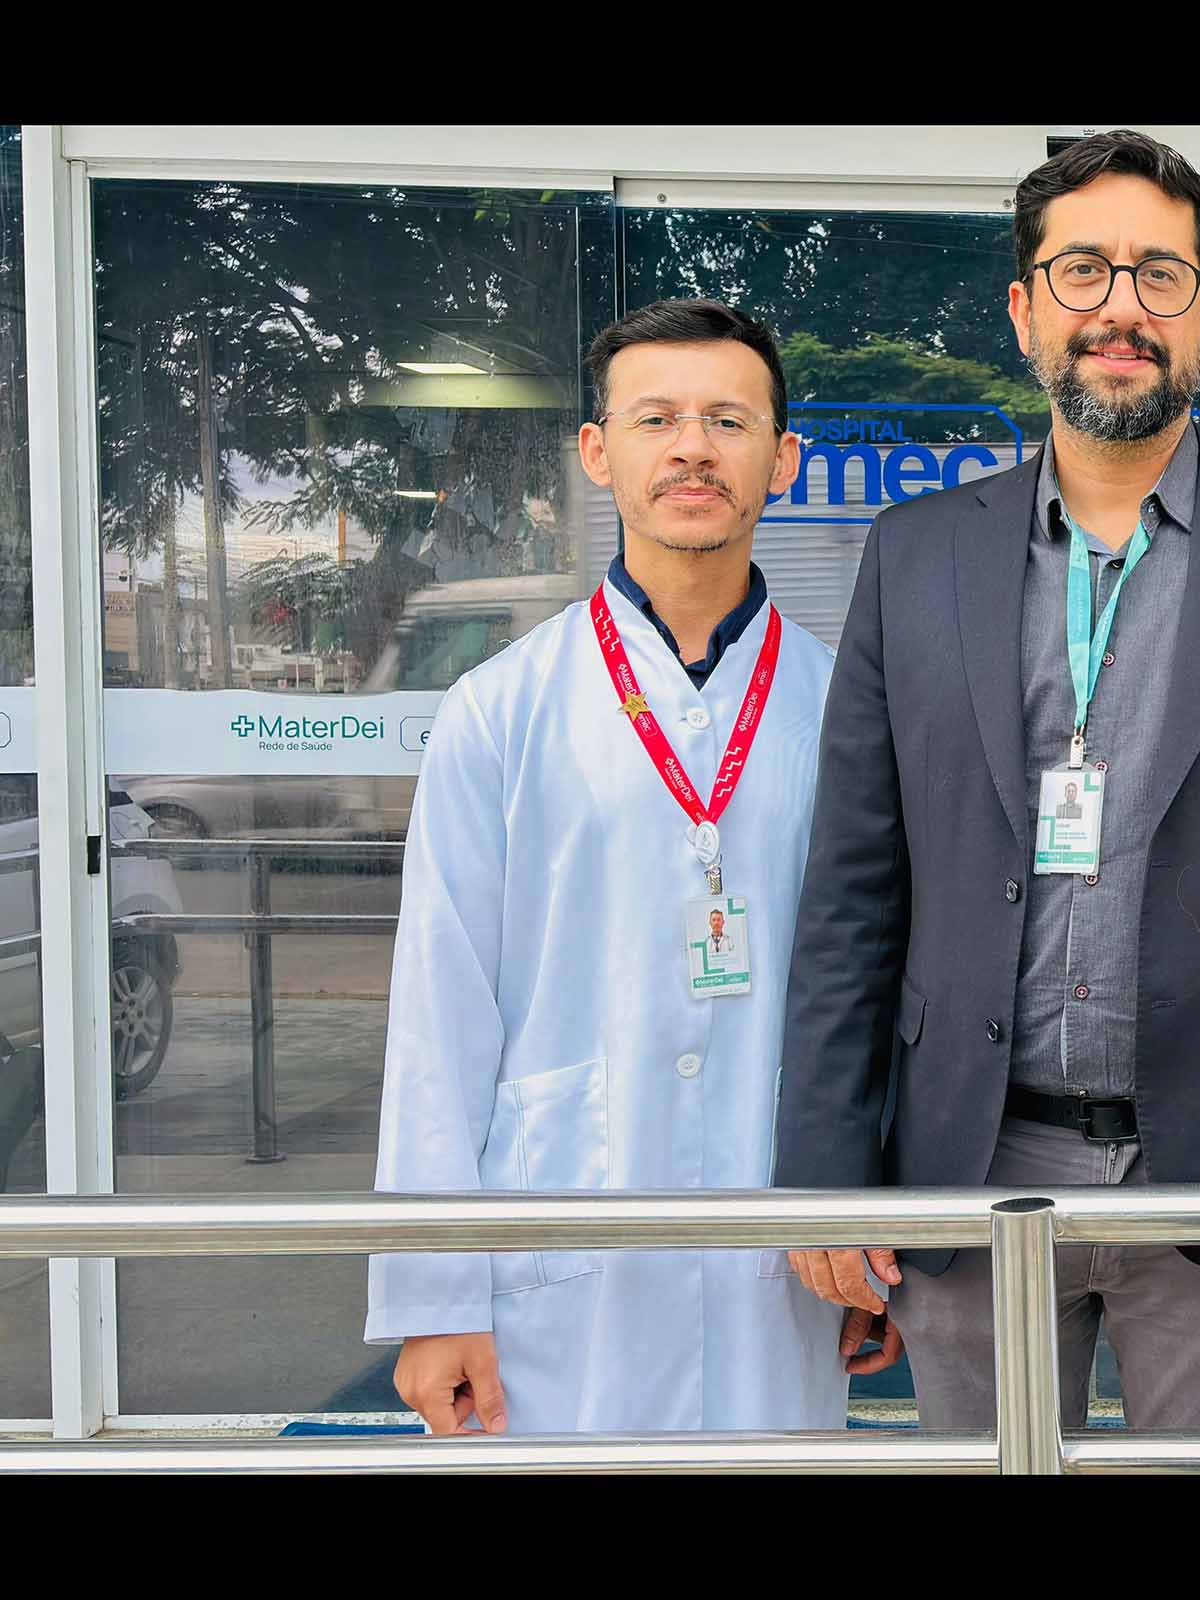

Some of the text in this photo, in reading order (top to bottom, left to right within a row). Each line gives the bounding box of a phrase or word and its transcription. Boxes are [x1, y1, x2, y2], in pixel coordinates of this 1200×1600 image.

[788, 419, 912, 441] HOSPITAL
[767, 443, 999, 505] mec
[258, 716, 385, 739] MaterDei
[259, 741, 333, 751] Rede de Saúde
[669, 763, 694, 801] MaterDei
